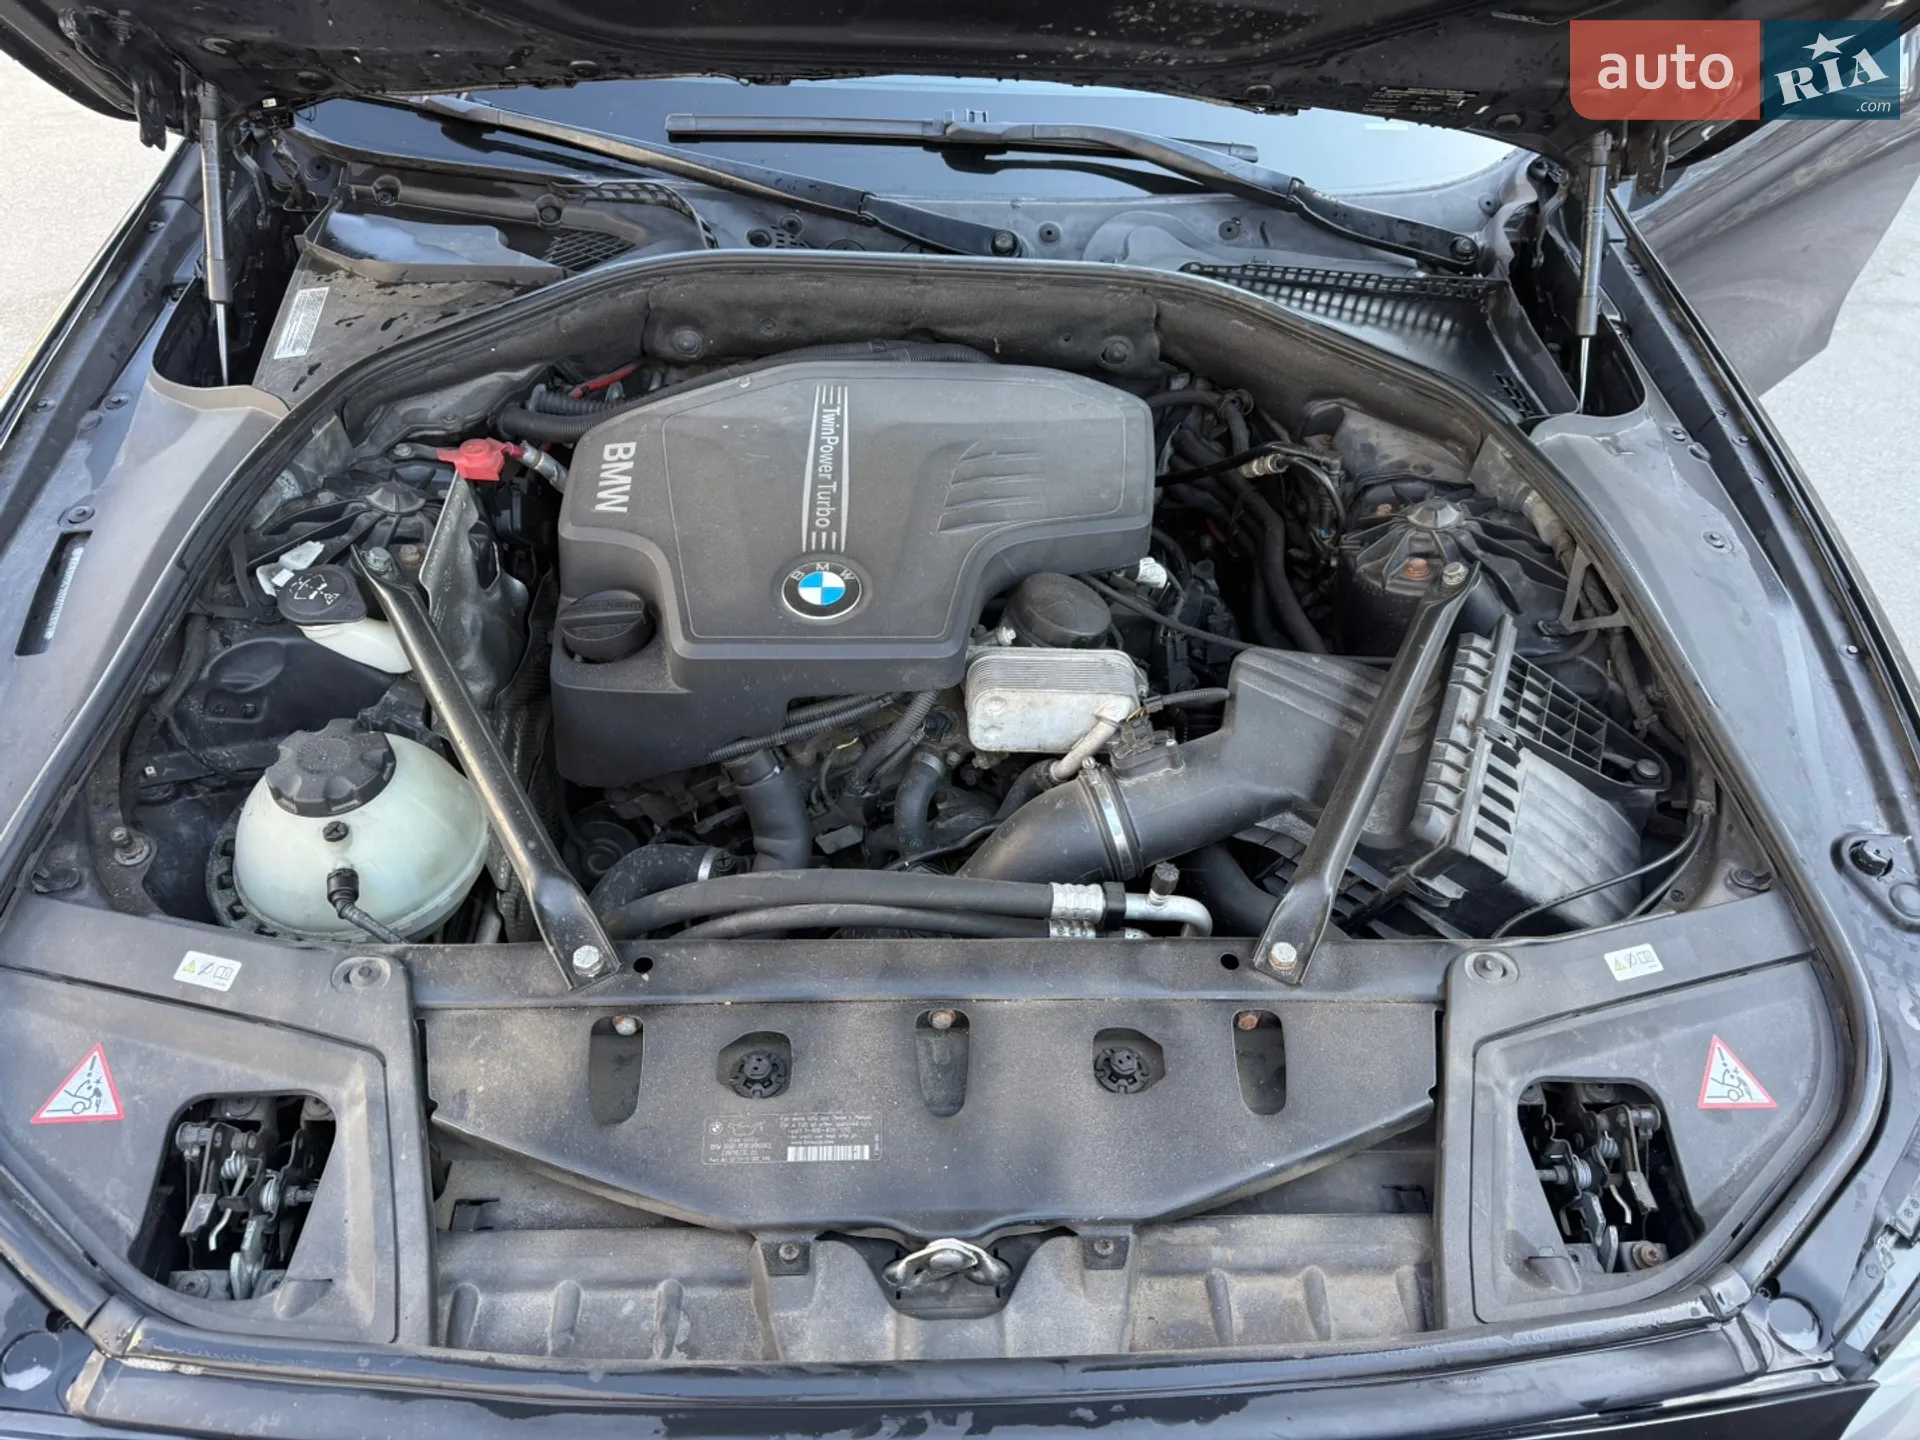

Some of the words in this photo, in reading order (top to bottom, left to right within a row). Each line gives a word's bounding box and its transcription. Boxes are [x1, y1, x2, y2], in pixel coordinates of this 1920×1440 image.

[818, 406, 841, 479] TwinPower
[595, 442, 637, 513] BMW
[815, 481, 837, 528] Turbo
[790, 562, 856, 581] BMW
